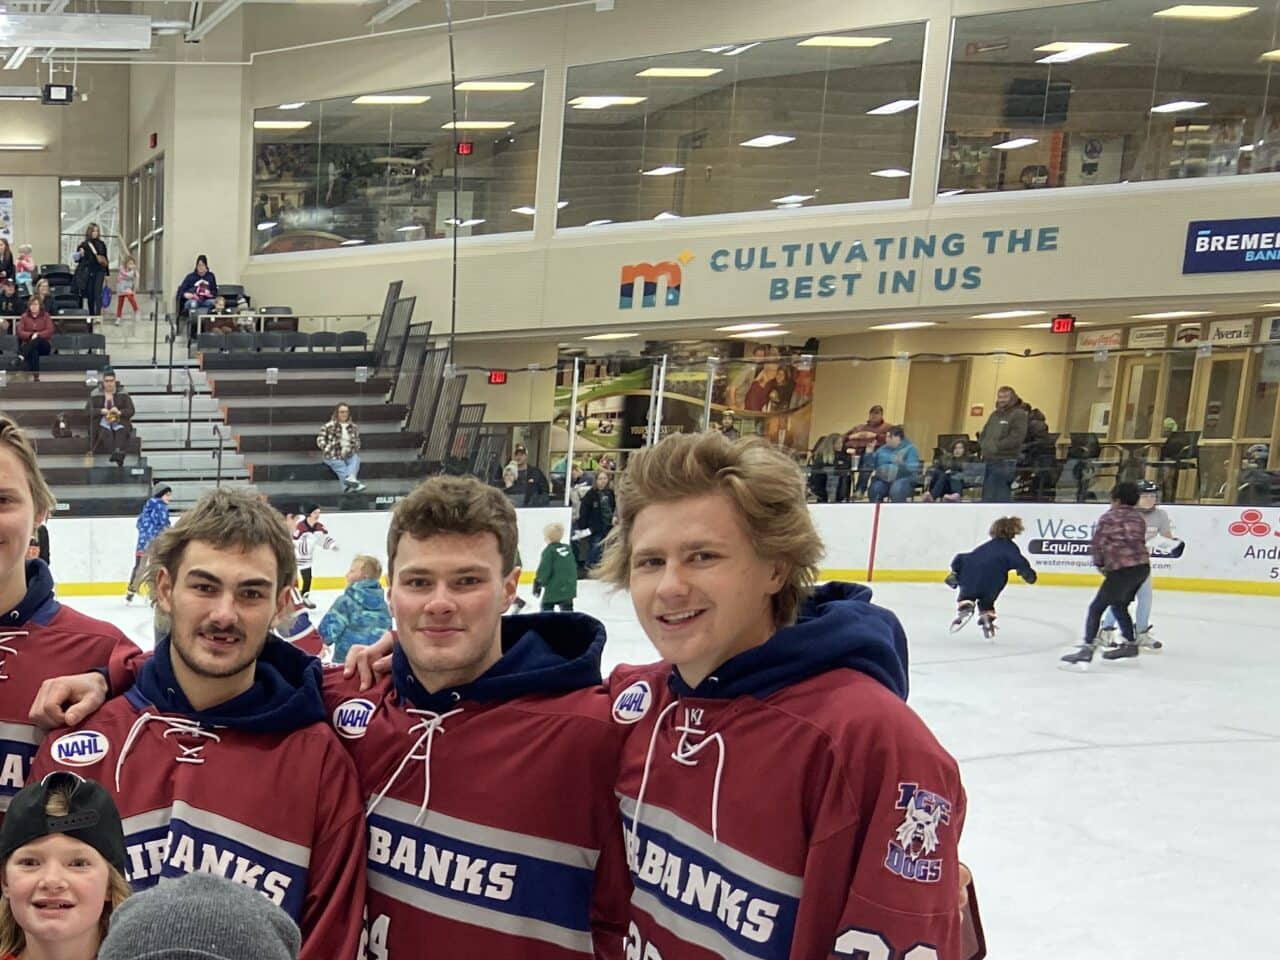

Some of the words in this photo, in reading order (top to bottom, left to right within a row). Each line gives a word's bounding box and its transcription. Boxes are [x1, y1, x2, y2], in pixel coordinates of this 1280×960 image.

[710, 232, 965, 272] CULTIVATING
[982, 226, 1059, 255] THE
[769, 273, 862, 301] BEST
[879, 269, 915, 295] IN
[934, 266, 983, 291] US
[1036, 518, 1096, 539] West
[1042, 540, 1091, 554] Equipm
[1244, 545, 1280, 560] And
[617, 691, 645, 713] NAHL
[336, 708, 371, 729] NAHL
[57, 736, 105, 757] NAHL
[895, 782, 952, 826] ICE
[883, 839, 943, 883] DOGS
